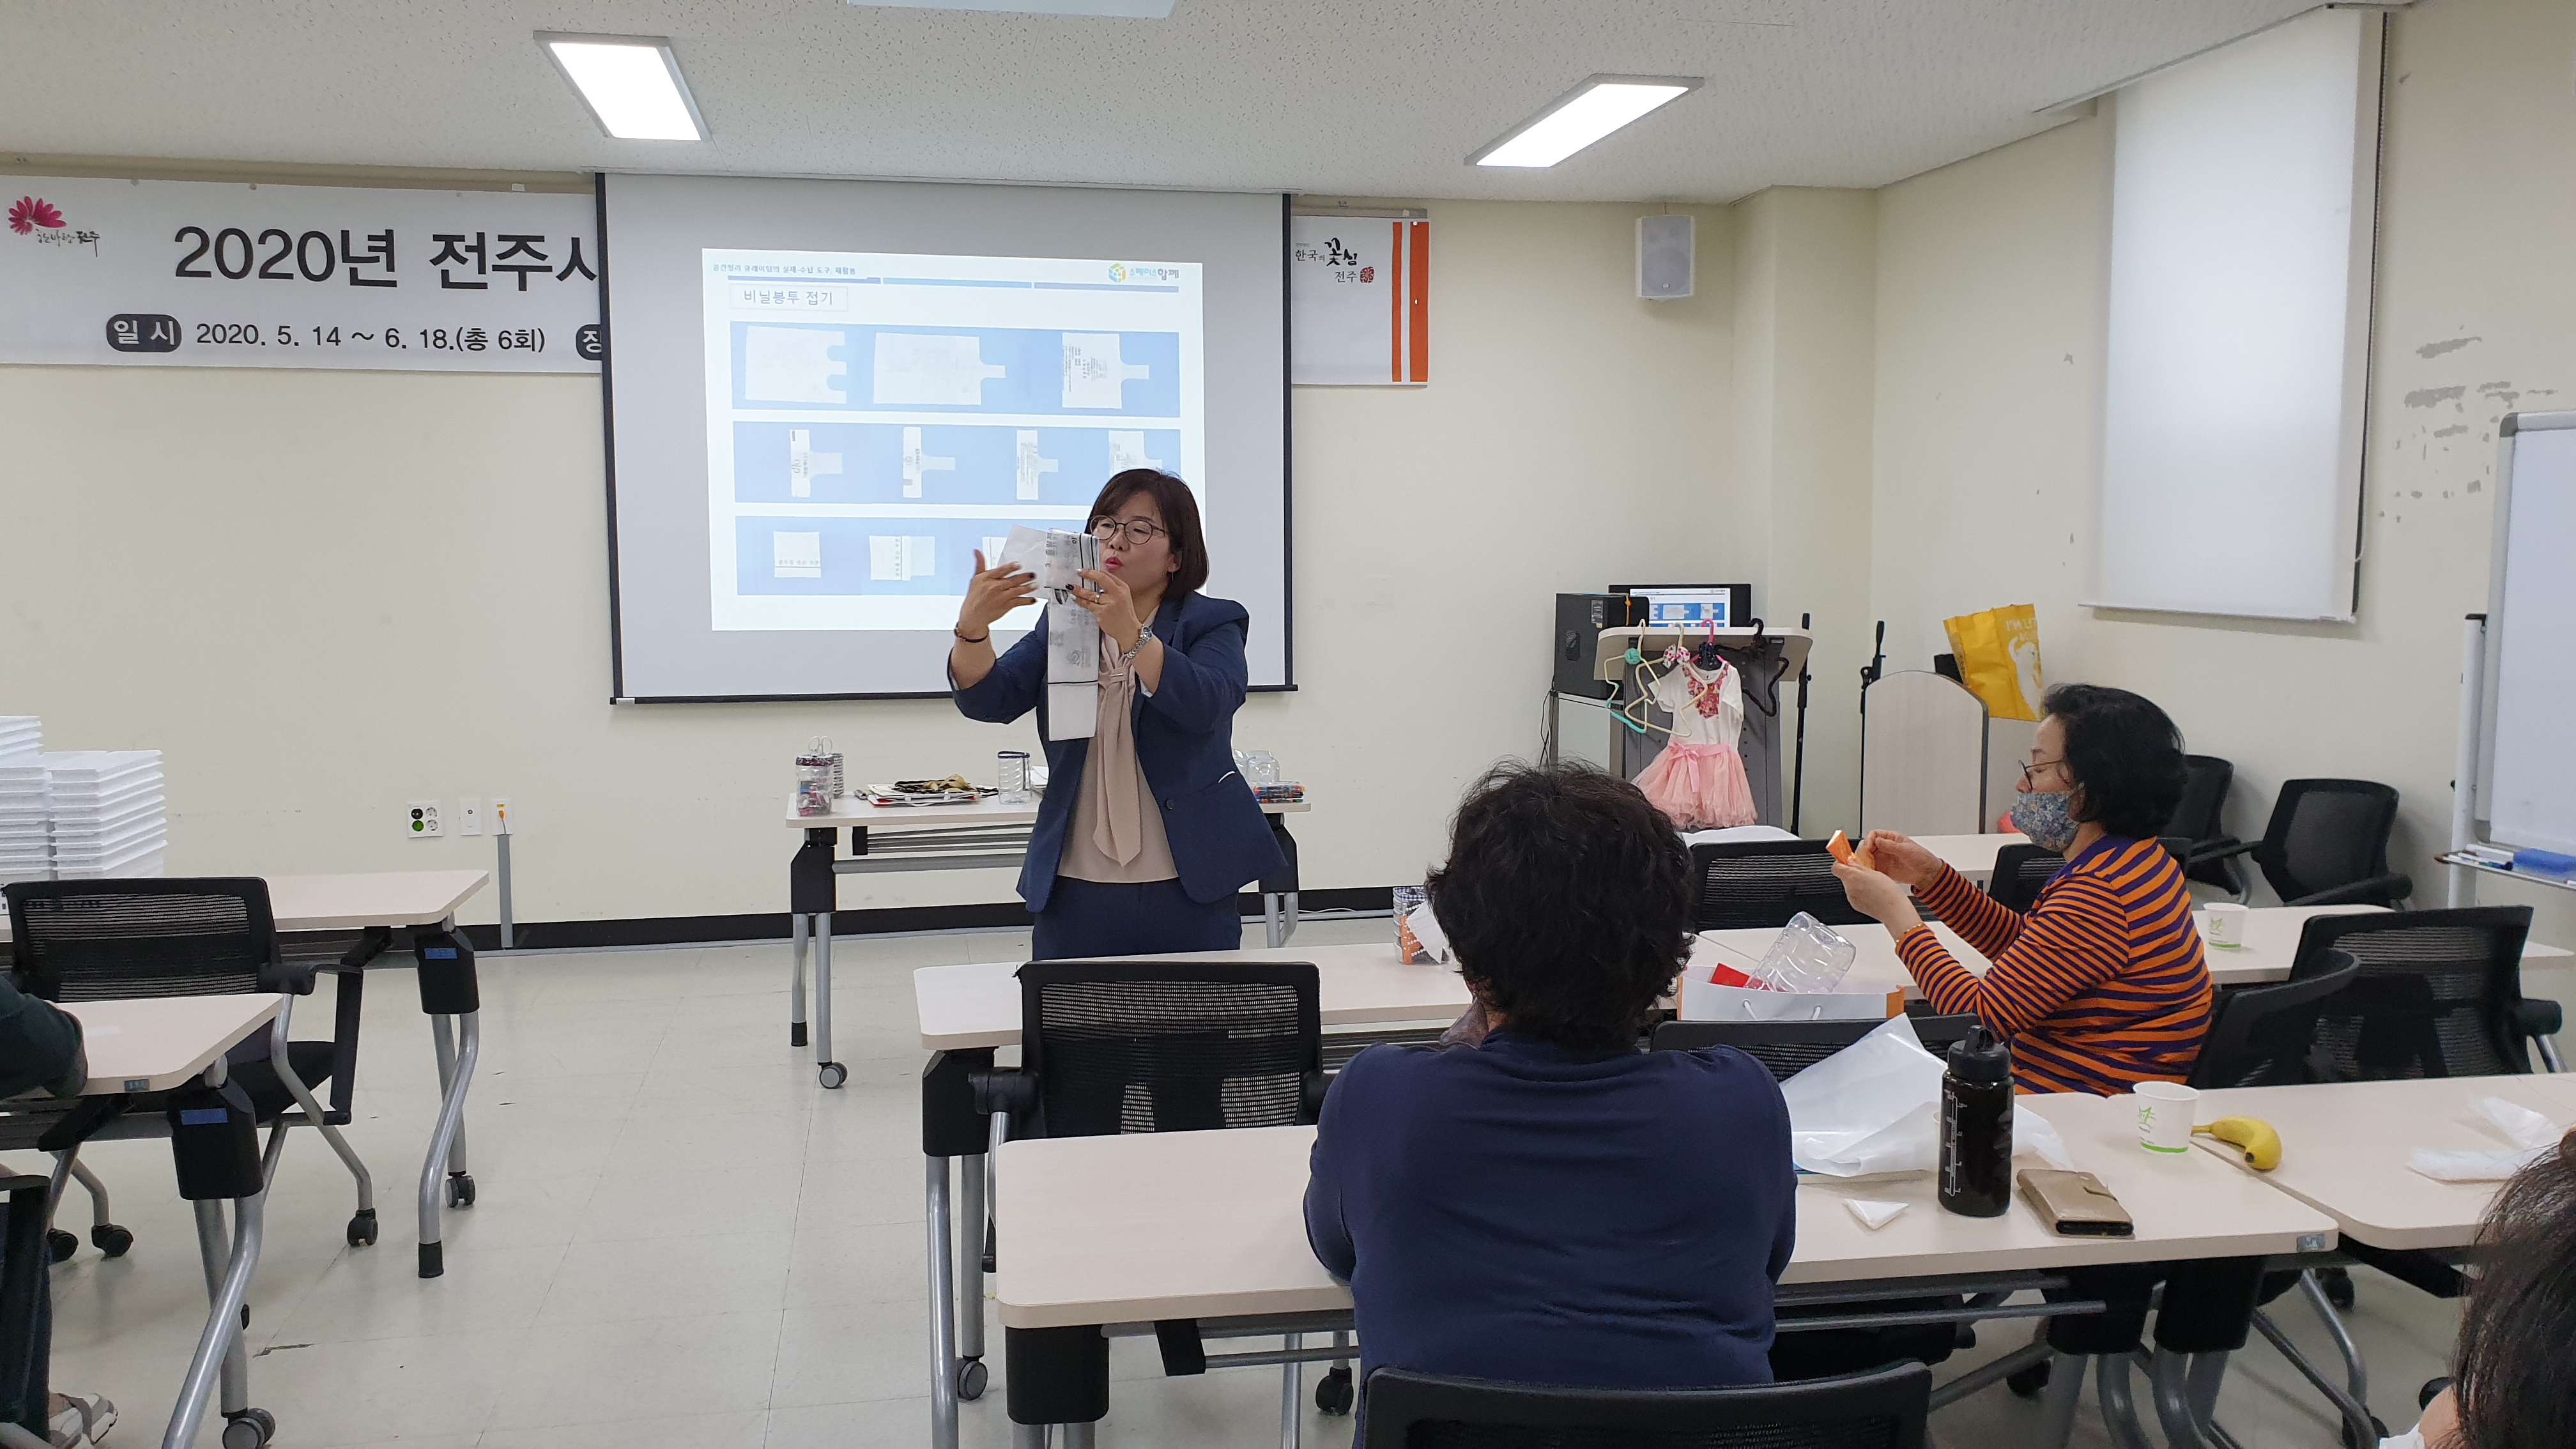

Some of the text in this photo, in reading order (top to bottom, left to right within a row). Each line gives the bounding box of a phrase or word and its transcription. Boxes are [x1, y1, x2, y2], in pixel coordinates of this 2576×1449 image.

[174, 226, 397, 288] 2020년
[1335, 271, 1358, 282] 전주
[744, 290, 833, 305] 비닐봉투 접기
[196, 323, 266, 346] 2020.
[312, 326, 341, 346] 14
